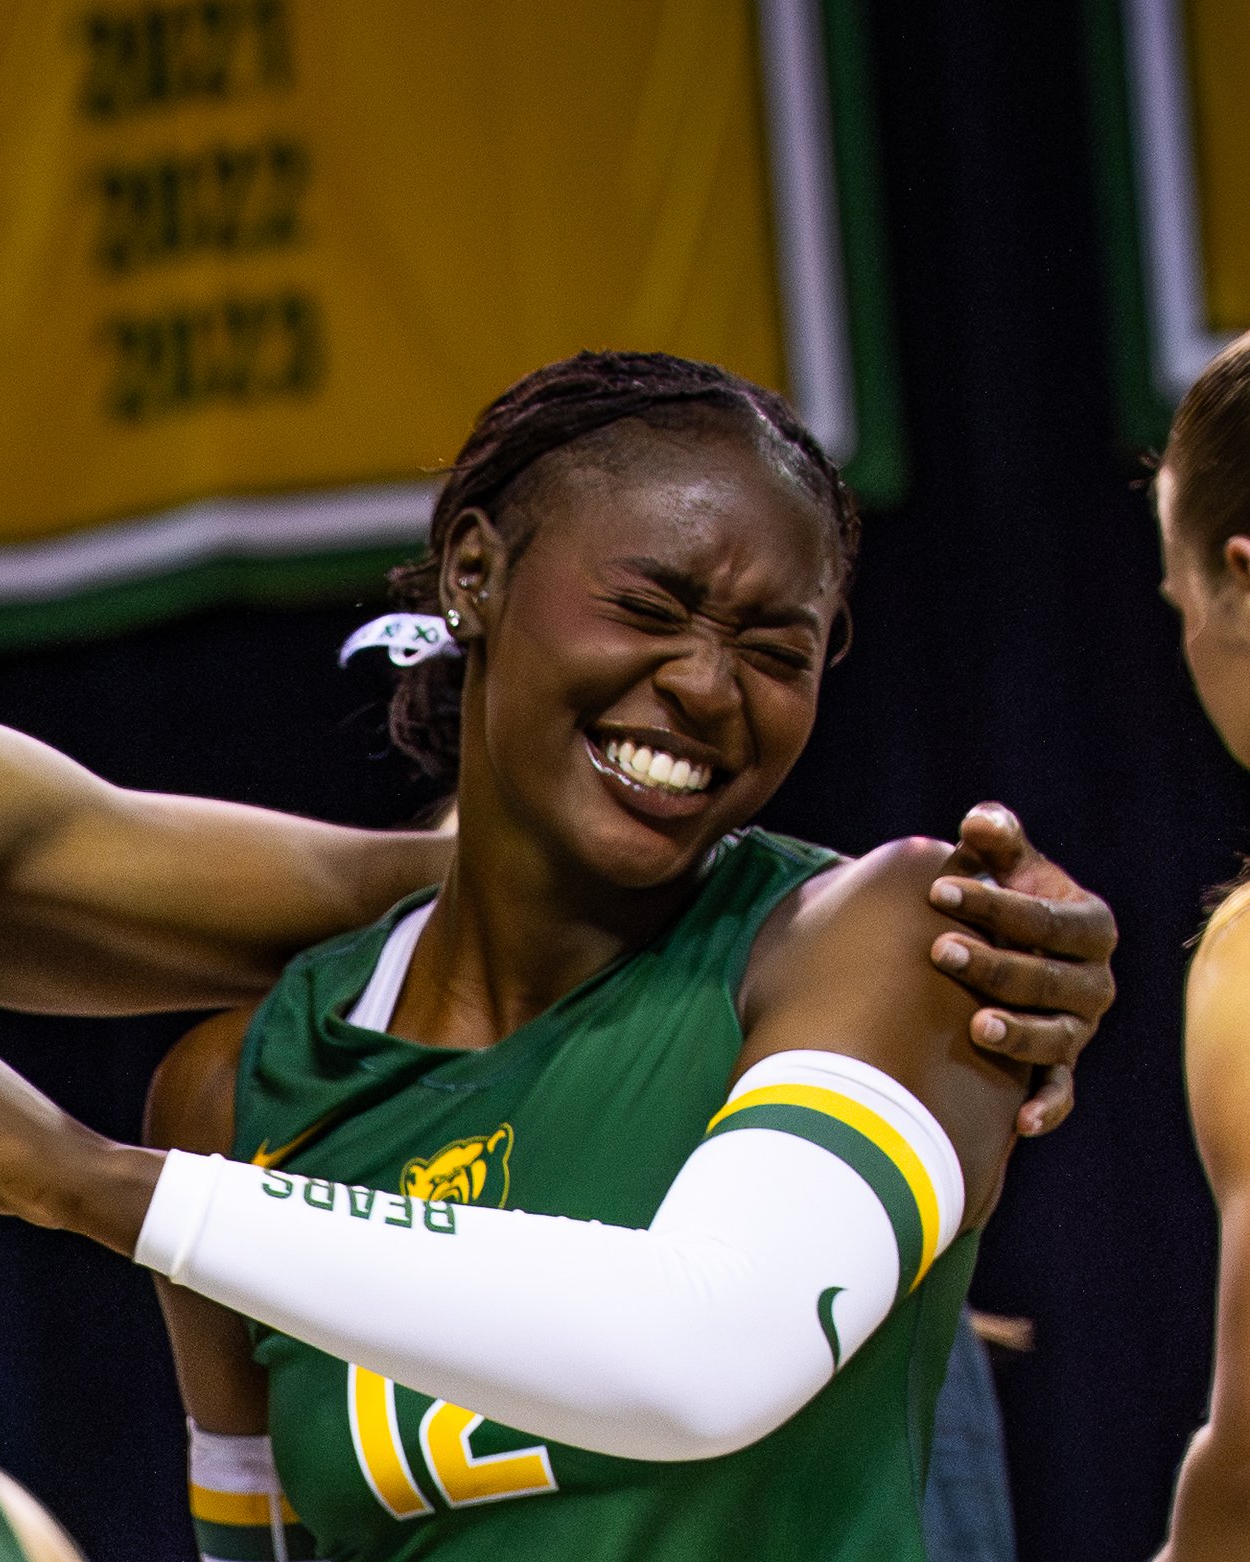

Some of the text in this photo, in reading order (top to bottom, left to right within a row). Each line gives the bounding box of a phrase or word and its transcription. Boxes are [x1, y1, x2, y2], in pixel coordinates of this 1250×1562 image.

[97, 136, 311, 270] 2022
[107, 291, 323, 422] 2023
[261, 1168, 457, 1236] BEARS
